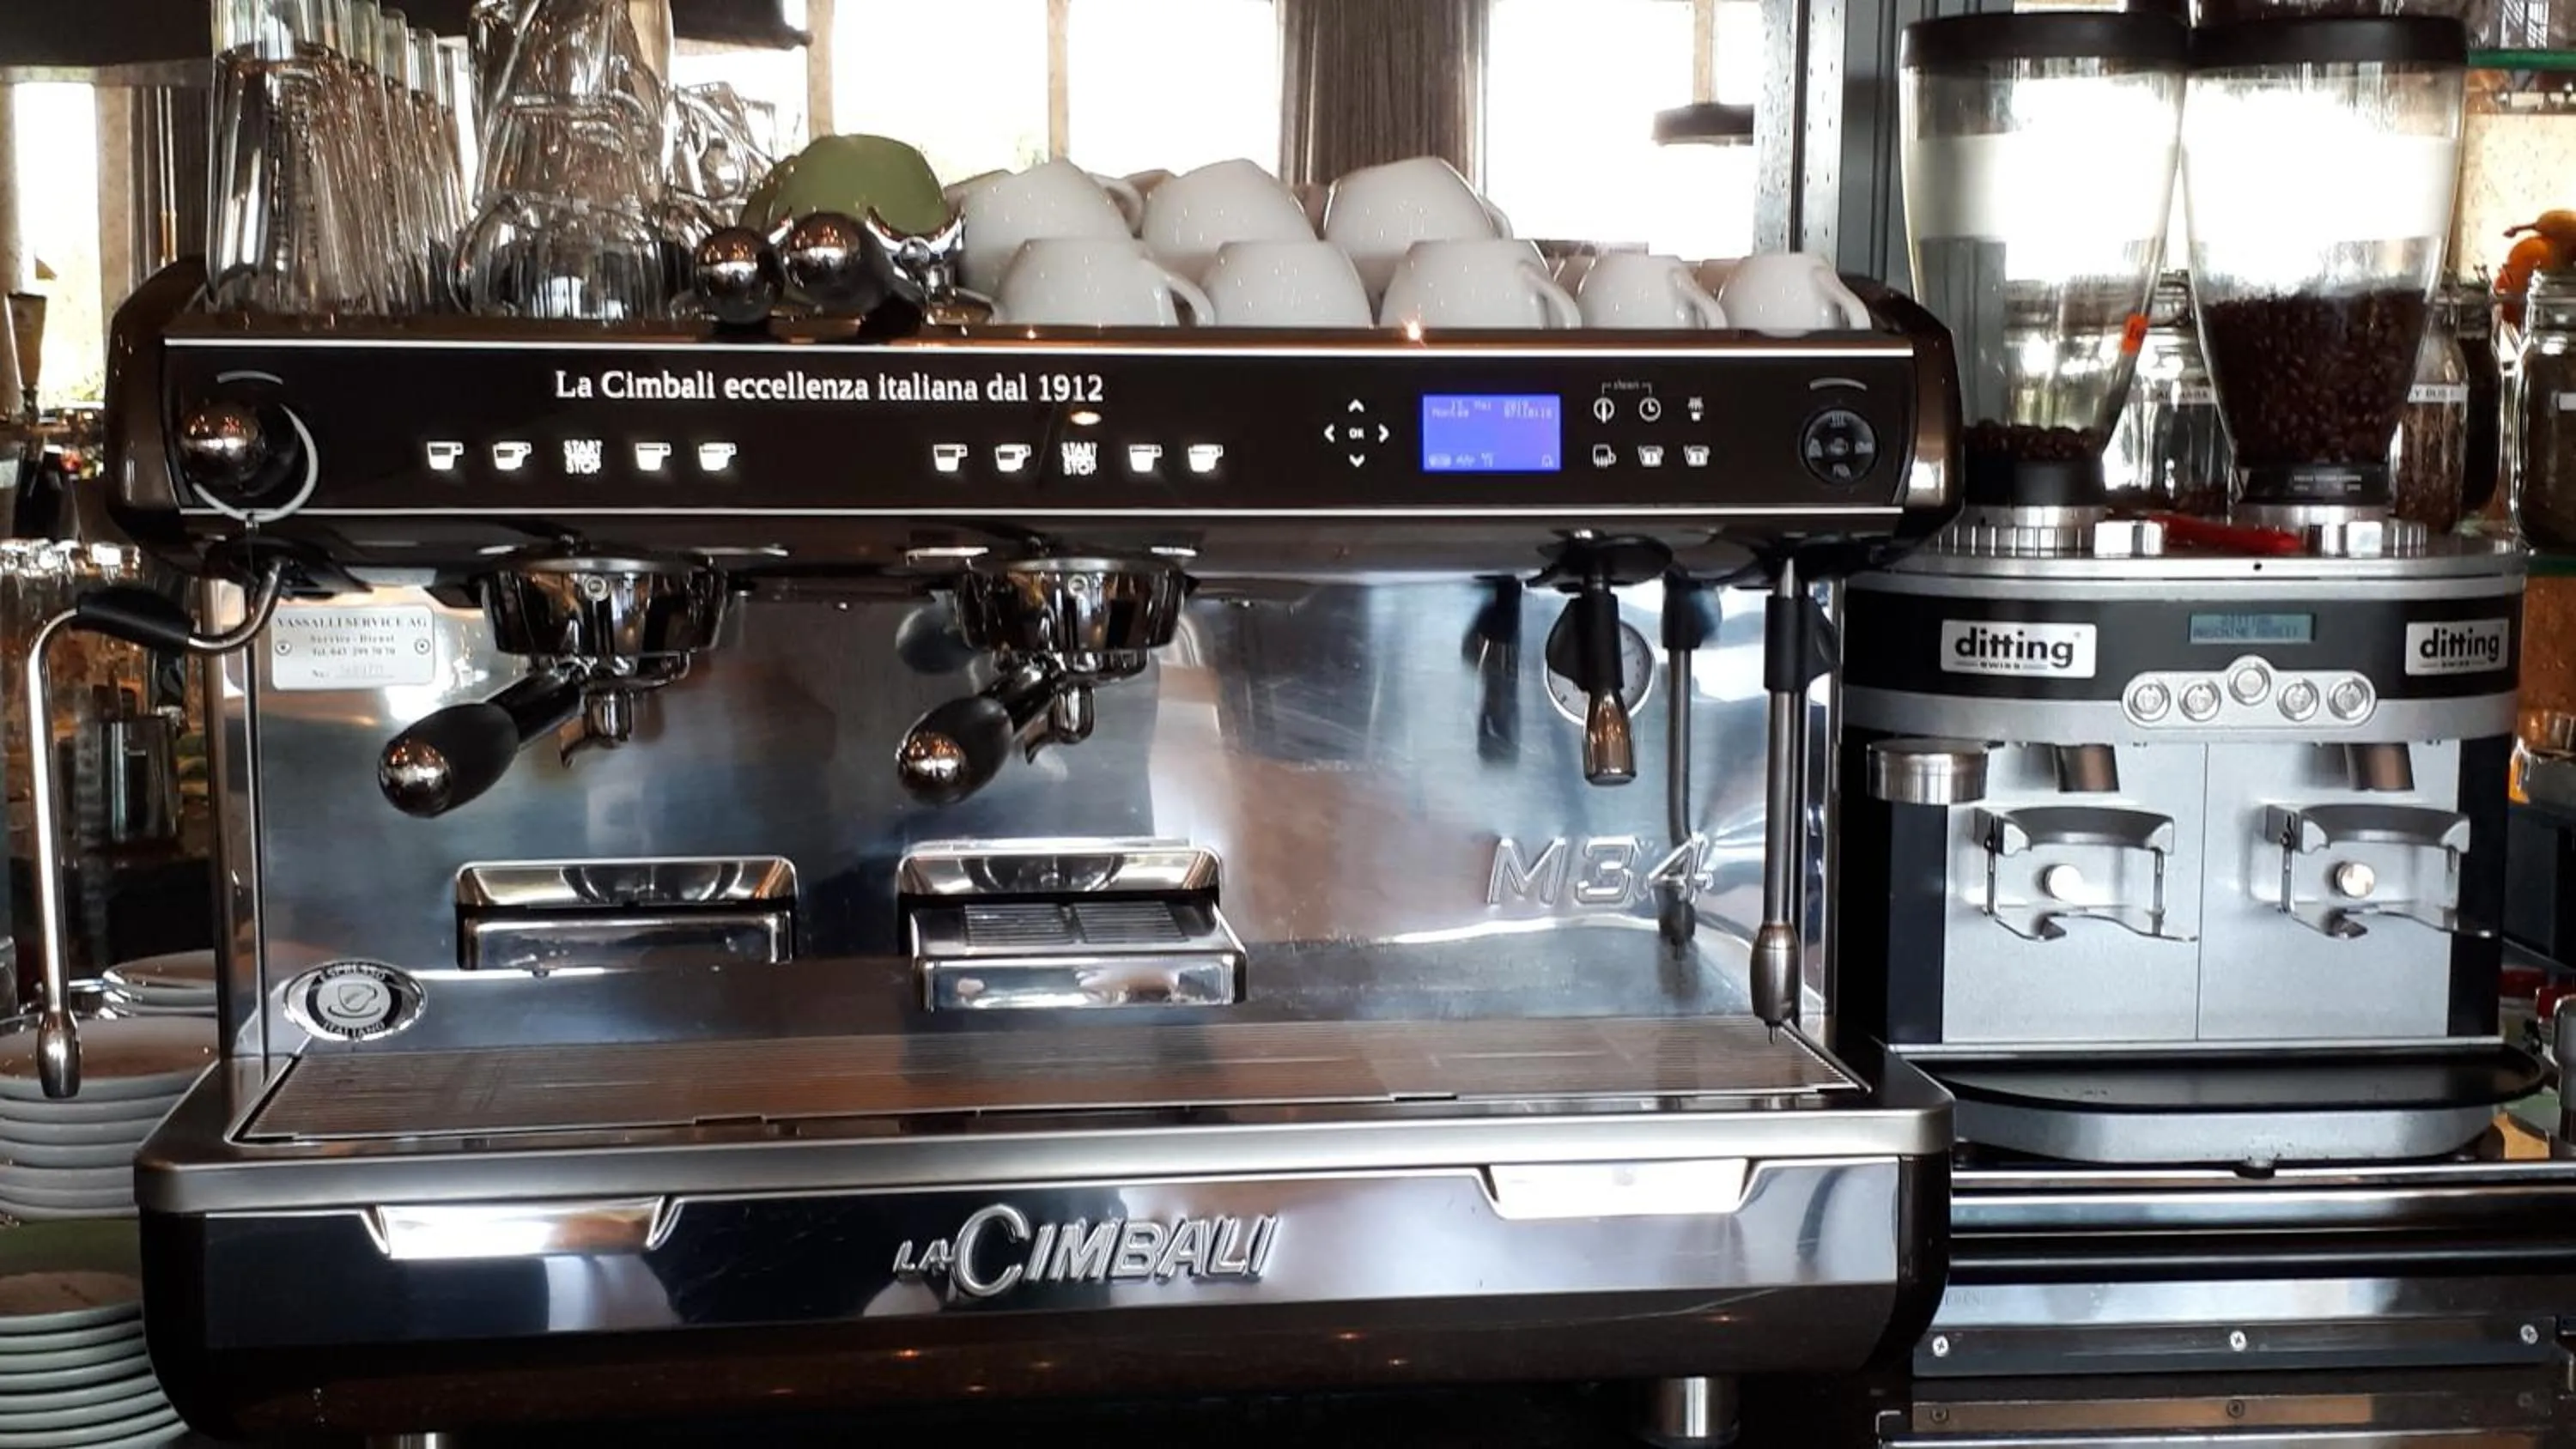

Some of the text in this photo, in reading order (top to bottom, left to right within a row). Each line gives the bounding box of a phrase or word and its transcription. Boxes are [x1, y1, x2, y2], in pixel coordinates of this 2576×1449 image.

[556, 370, 1103, 403] La Cimbali eccellenza italiana dal 1912
[563, 440, 602, 456] START
[1061, 442, 1097, 458] START
[566, 456, 602, 474] STOP
[1063, 458, 1097, 476] STOP
[1955, 627, 2074, 669] ditting
[2420, 627, 2500, 663] ditting
[1486, 833, 1712, 908] M34
[892, 1203, 1279, 1298] LA CIMBALI
